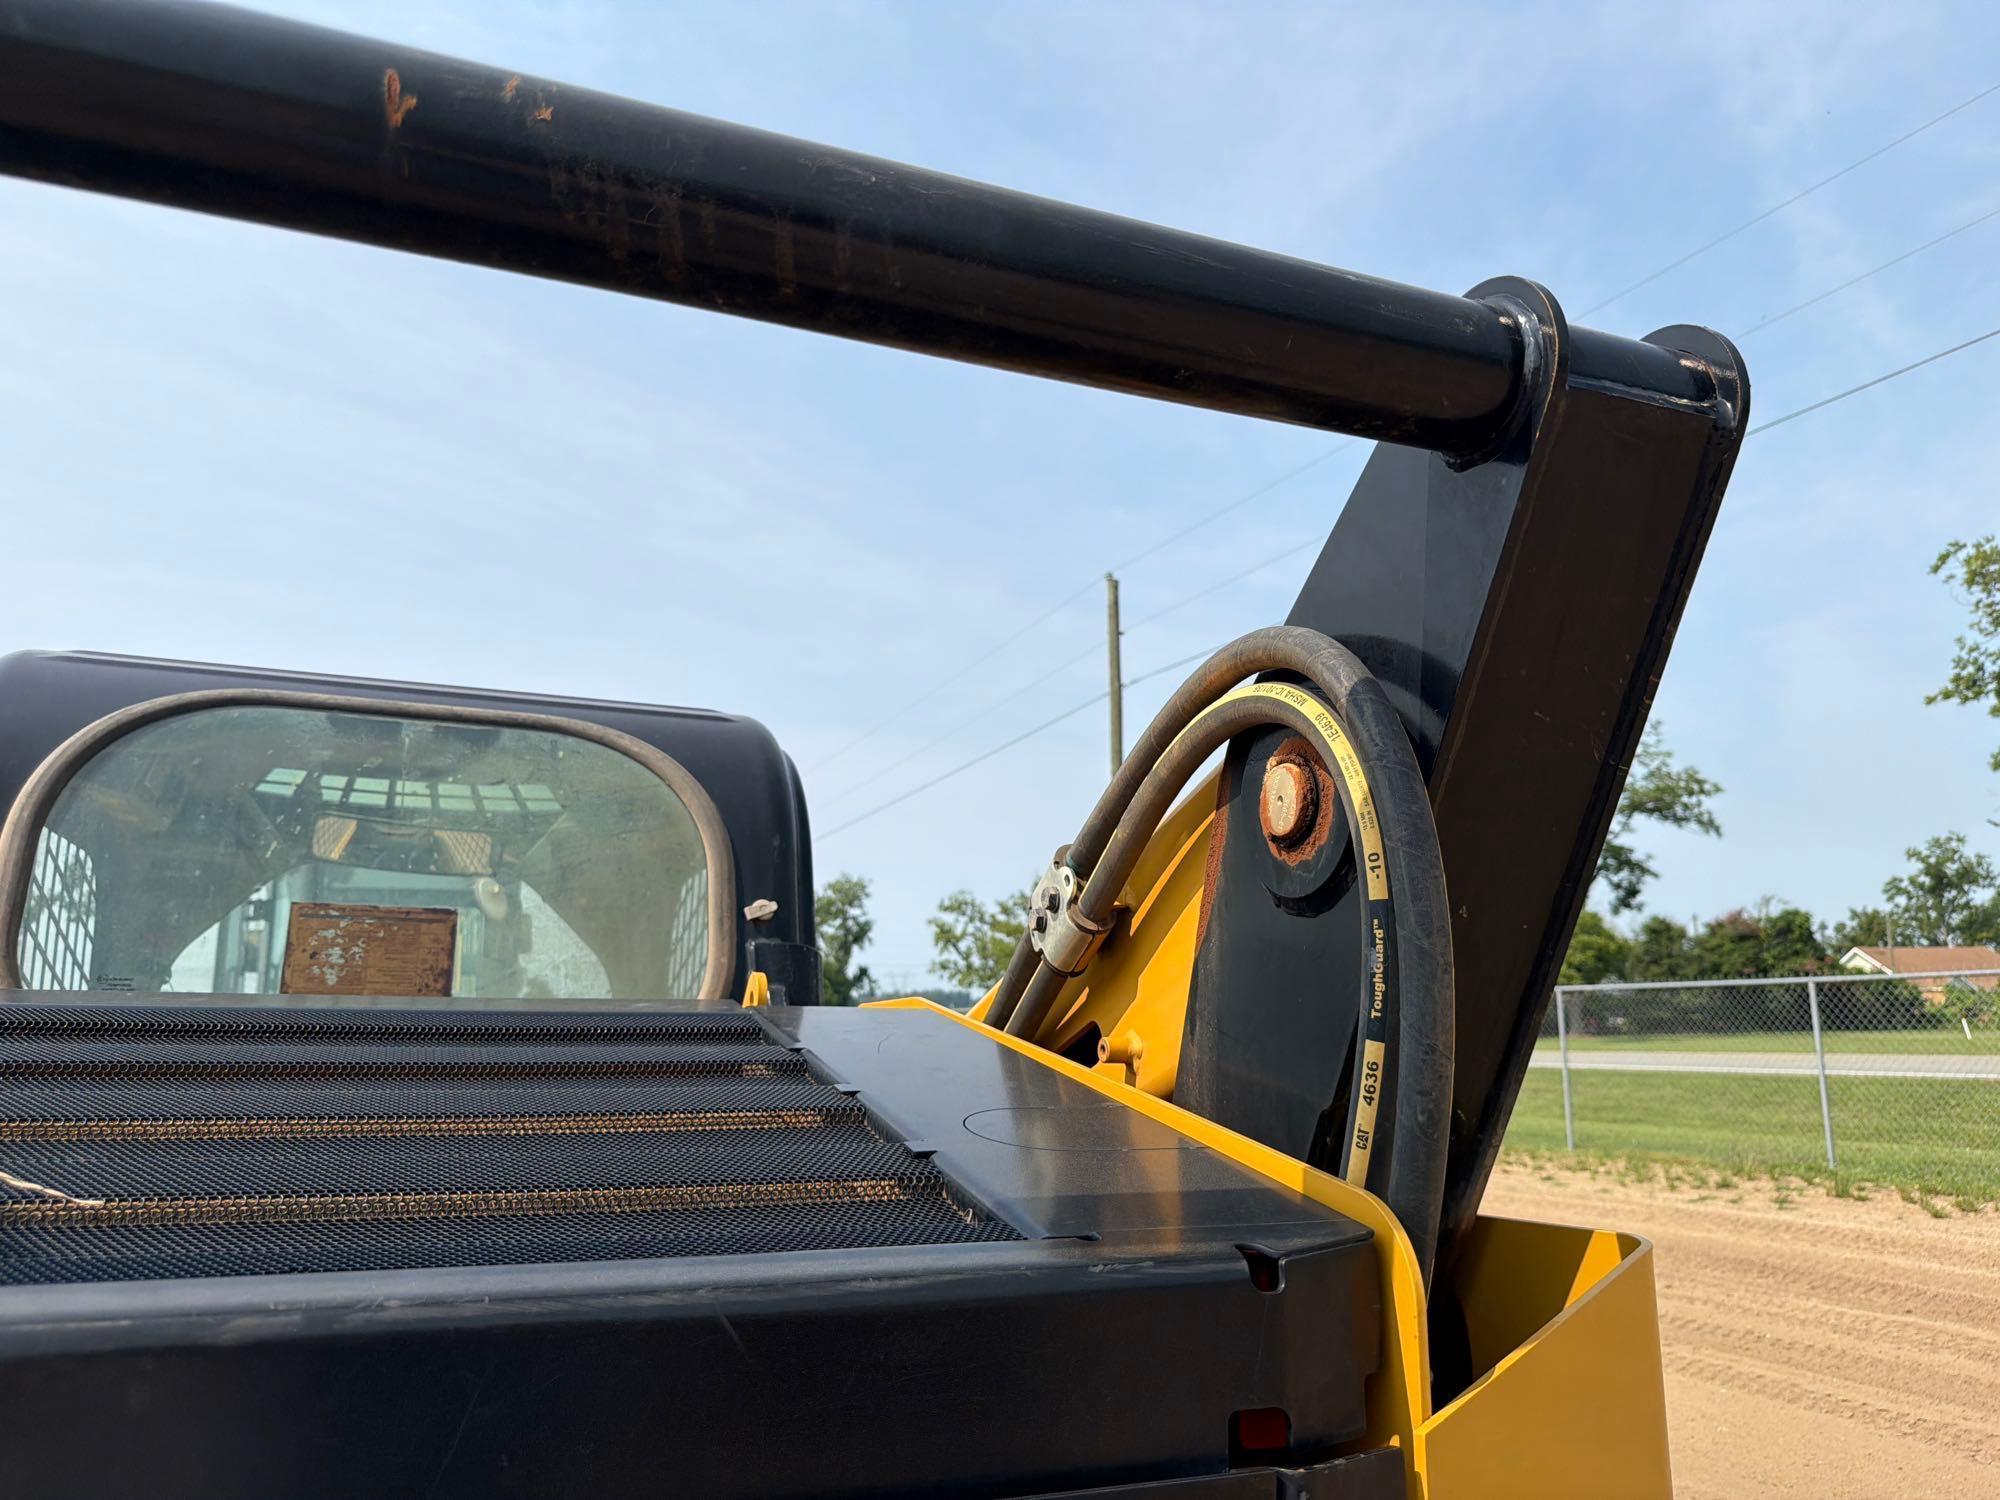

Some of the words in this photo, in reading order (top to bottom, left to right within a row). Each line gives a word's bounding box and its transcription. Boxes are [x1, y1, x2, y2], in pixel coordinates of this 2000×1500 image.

[1284, 690, 1308, 707] MSHA
[1315, 713, 1341, 741] 1E4639
[1367, 852, 1381, 879] -10
[1362, 1061, 1378, 1106] 4636
[1356, 1126, 1369, 1150] CAT
